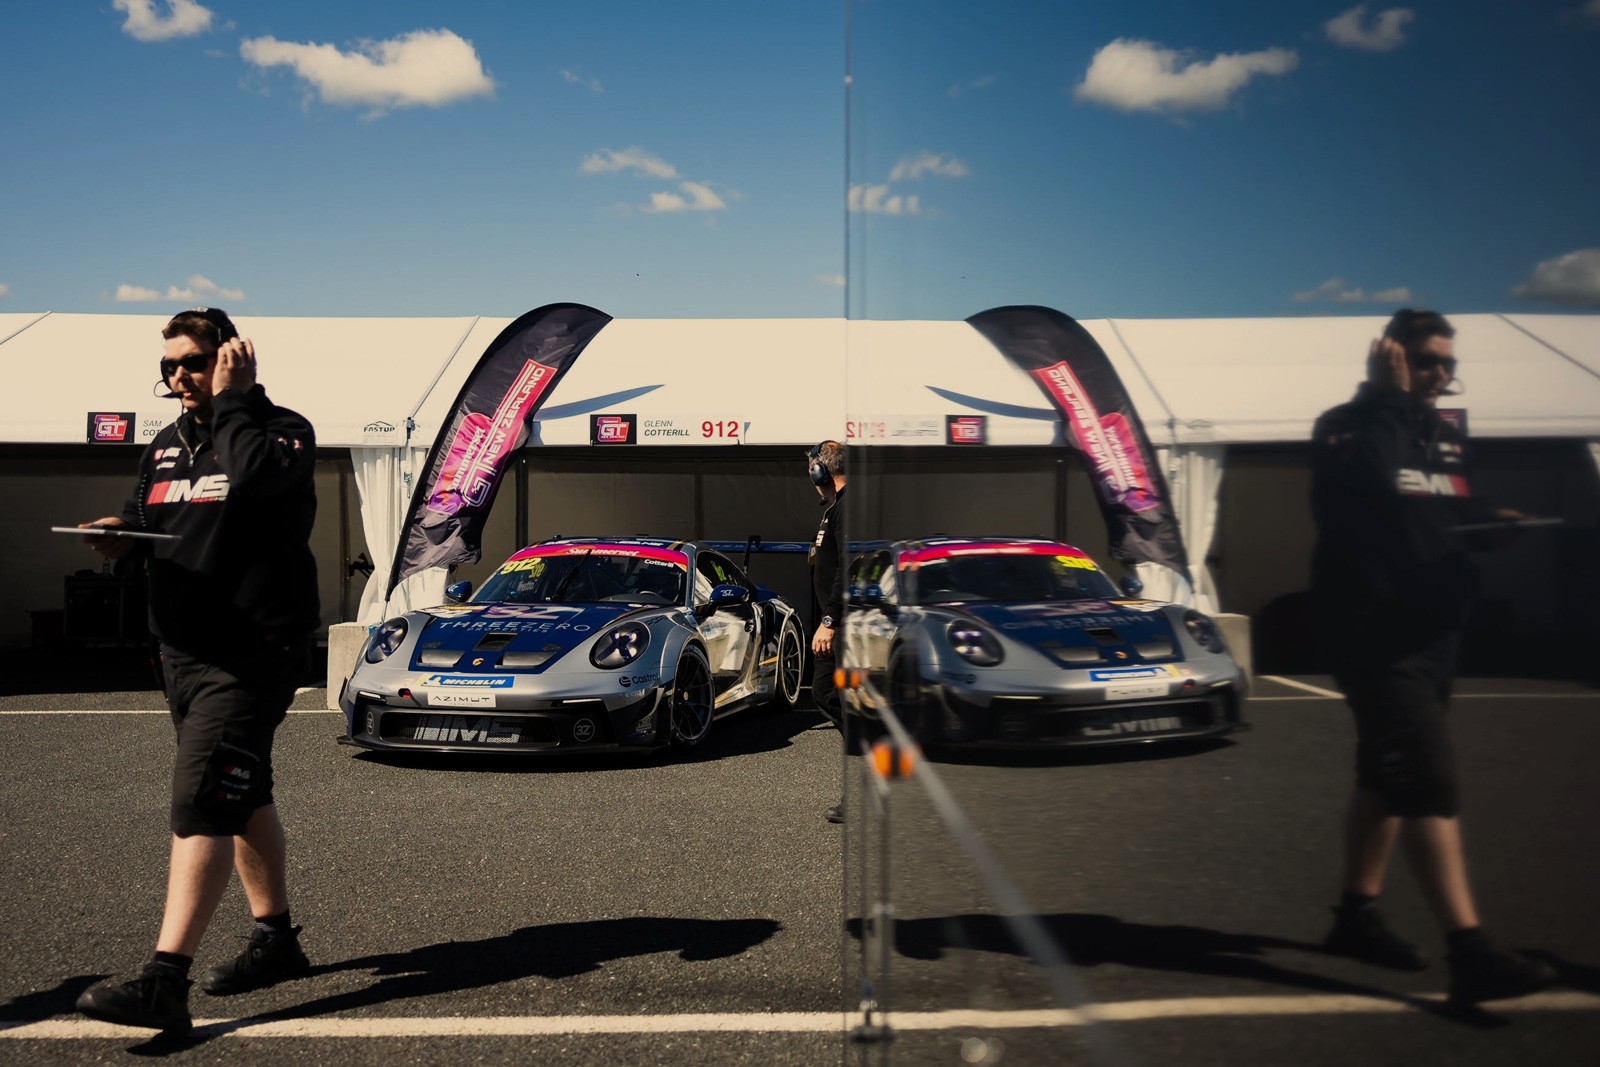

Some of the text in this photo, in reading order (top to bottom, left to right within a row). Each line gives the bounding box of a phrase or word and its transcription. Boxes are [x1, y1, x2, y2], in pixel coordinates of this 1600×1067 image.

[483, 430, 506, 465] NEW
[501, 367, 546, 429] ZEALAND
[98, 421, 126, 435] GT
[600, 423, 628, 436] GT
[644, 420, 673, 428] GLENN
[702, 420, 739, 438] 912
[644, 429, 690, 437] COTTERILL
[500, 557, 542, 574] 912
[443, 678, 506, 686] MICHELIN
